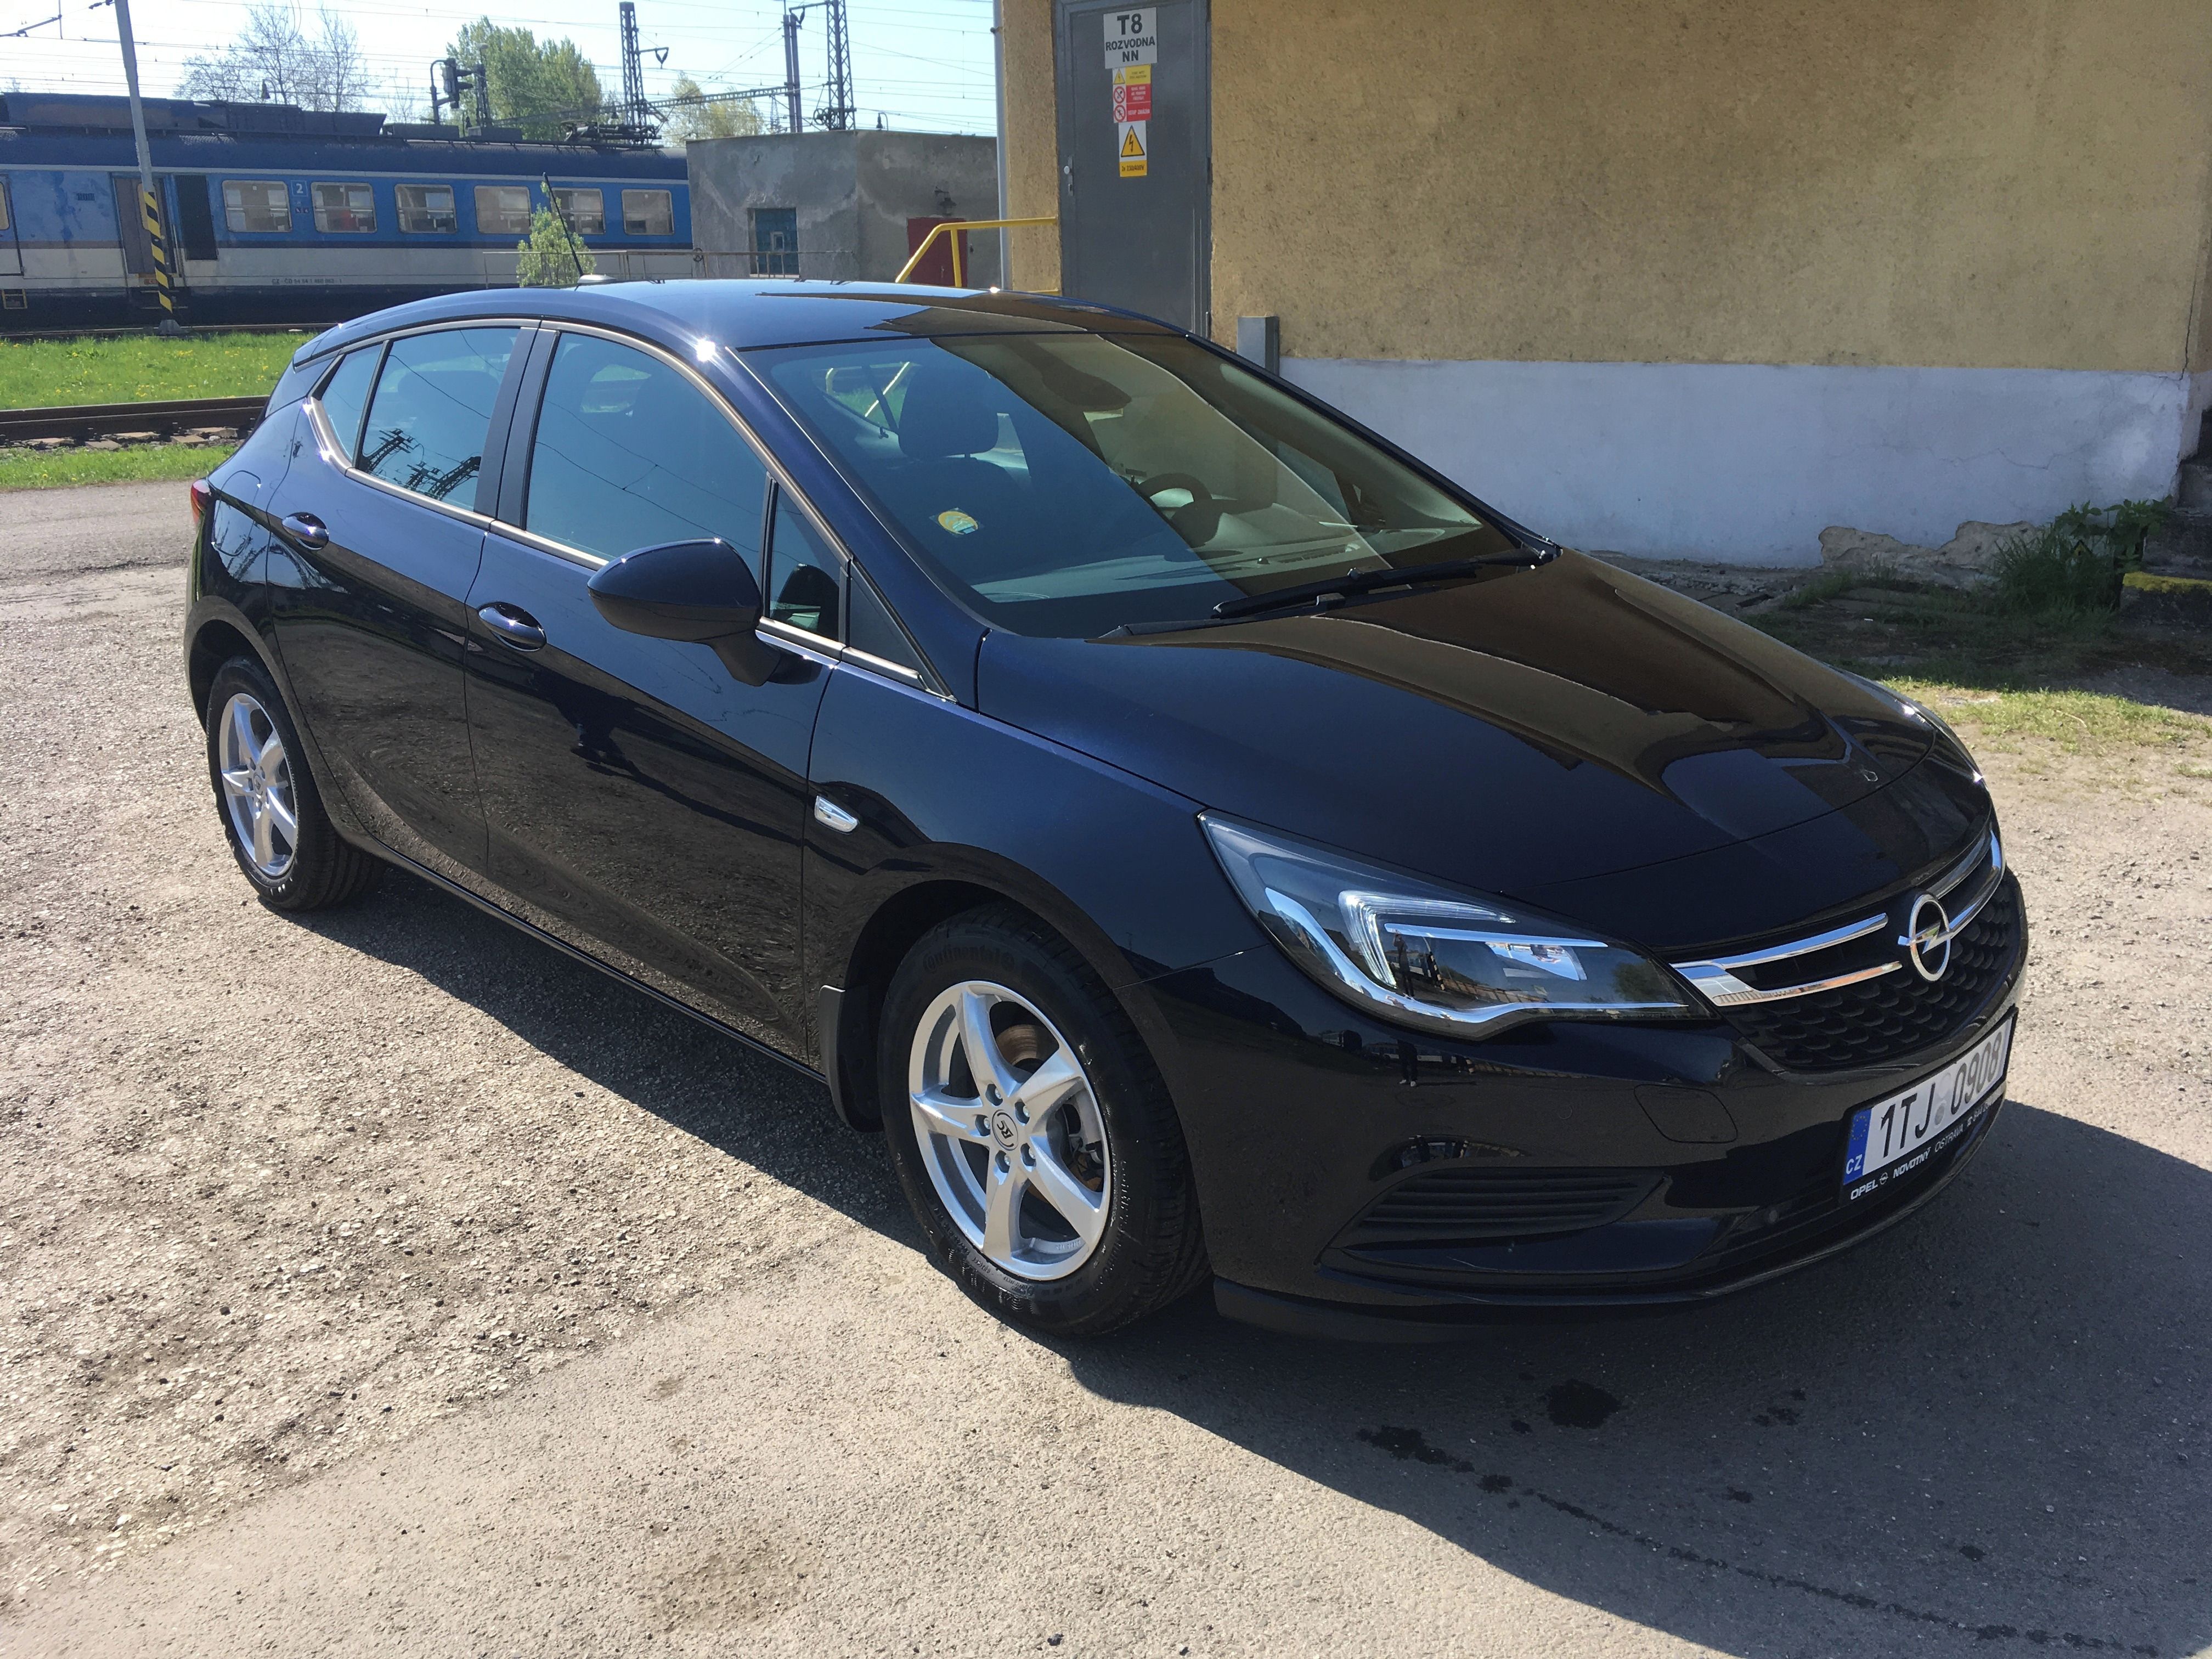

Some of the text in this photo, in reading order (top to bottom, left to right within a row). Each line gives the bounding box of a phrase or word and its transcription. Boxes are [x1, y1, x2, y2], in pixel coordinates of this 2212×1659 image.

[1117, 13, 1143, 35] T8
[1105, 36, 1155, 51] ROZVODNA
[1122, 50, 1138, 62] NN
[296, 183, 303, 193] 2
[1880, 1032, 2002, 1158] 1TJ 0908
[1846, 1154, 1863, 1175] CZ
[1850, 1179, 1878, 1200] OPEL
[1893, 1147, 1932, 1178] NOVOTNÝ
